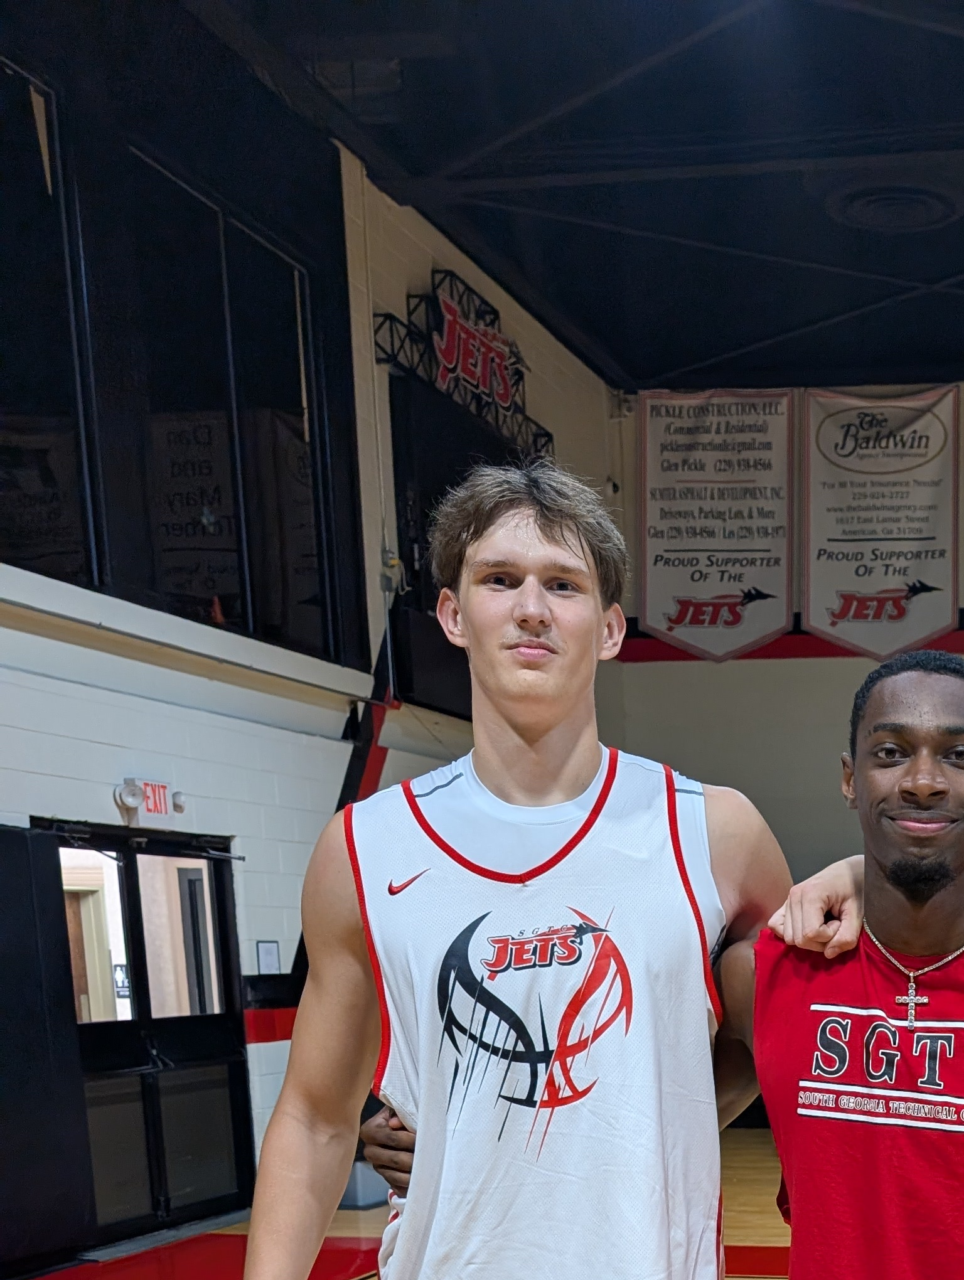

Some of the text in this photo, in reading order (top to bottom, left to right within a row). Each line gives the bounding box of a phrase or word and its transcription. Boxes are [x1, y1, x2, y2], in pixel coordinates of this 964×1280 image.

[432, 294, 516, 413] JETS
[650, 404, 685, 419] PICKLE
[858, 411, 888, 431] The
[834, 423, 930, 458] Baldwin
[661, 458, 679, 472] Glen
[682, 458, 706, 472] Pickle
[653, 554, 783, 568] PROUD SUPPORTER
[817, 547, 947, 562] PROUD SUPPORTER
[690, 570, 745, 583] OF THE
[855, 564, 910, 577] OF THE
[663, 596, 746, 628] JETS
[826, 590, 910, 623] JETS
[143, 781, 169, 815] EXIT
[480, 934, 583, 974] JETS
[797, 1090, 837, 1108] SOUTH
[839, 1094, 887, 1114] GEORGIA
[889, 1100, 957, 1122] TECHNICAL
